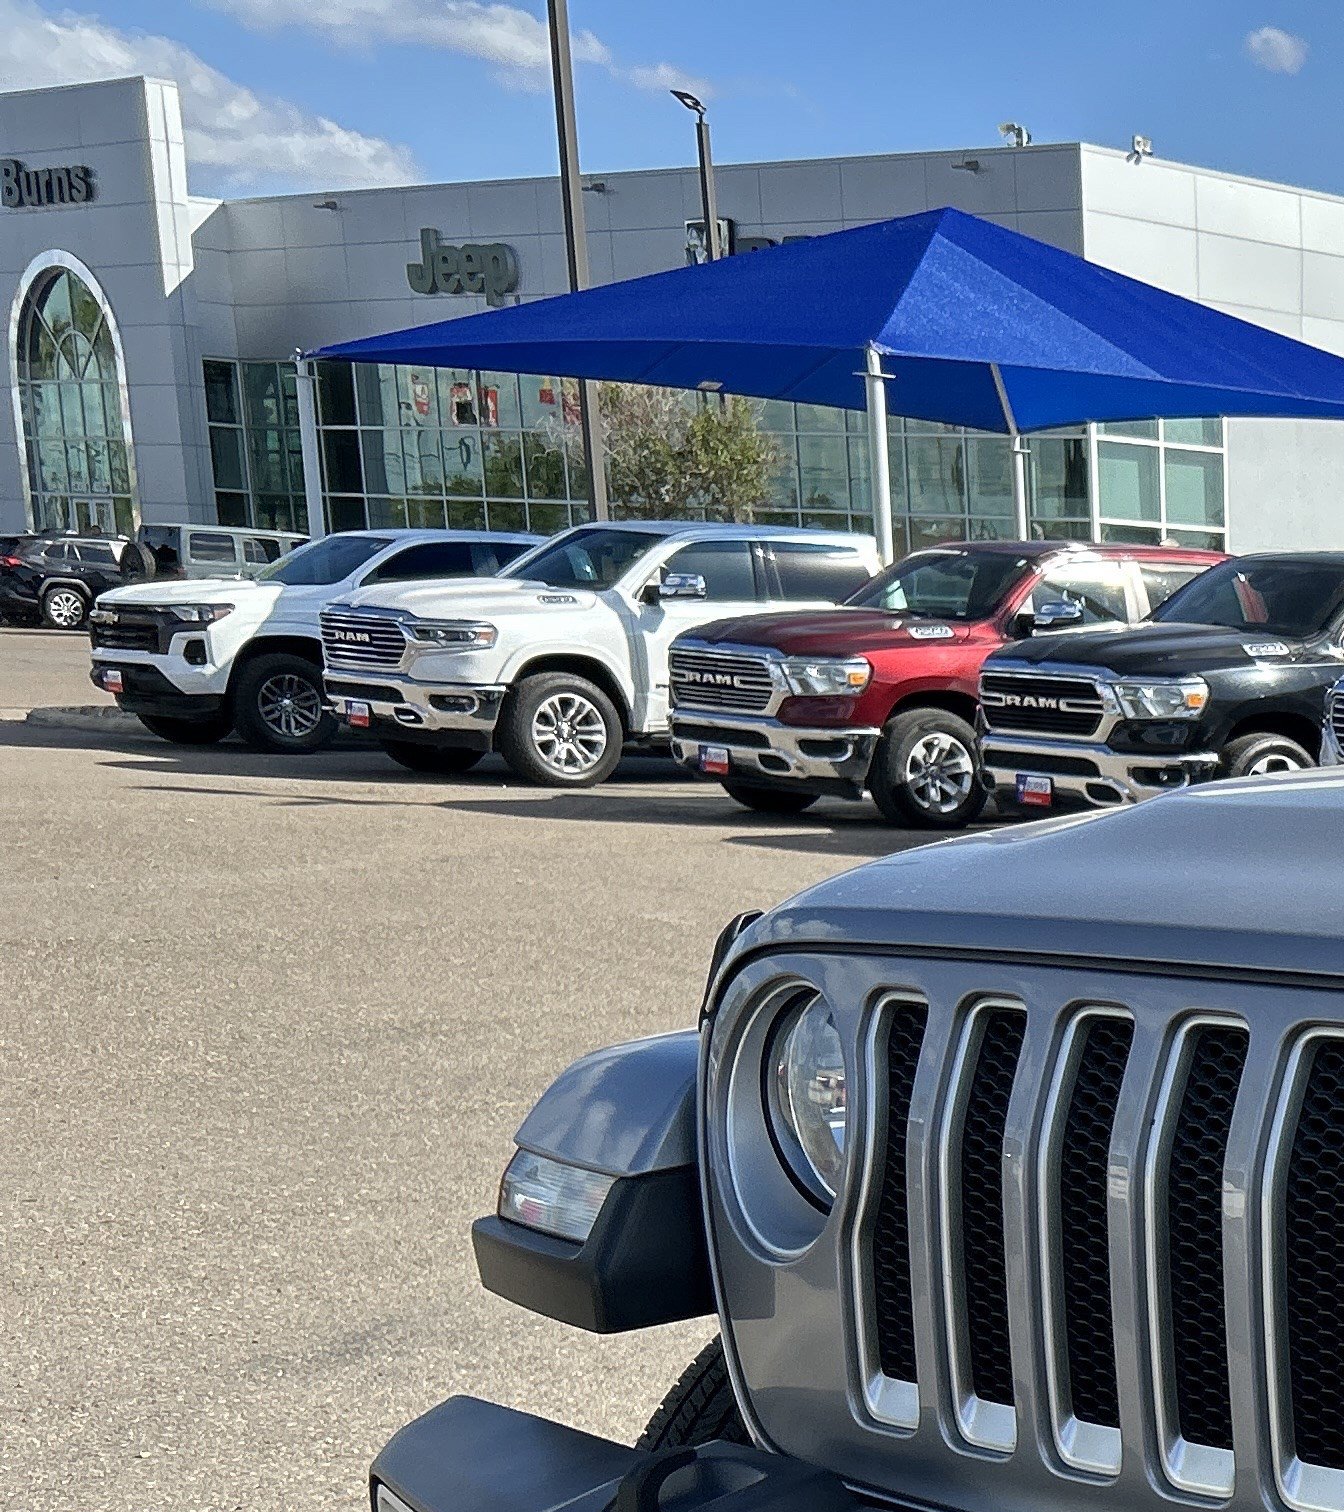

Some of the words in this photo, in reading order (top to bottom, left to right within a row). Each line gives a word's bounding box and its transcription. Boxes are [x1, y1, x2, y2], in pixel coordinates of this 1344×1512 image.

[0, 159, 92, 207] Burns
[407, 228, 519, 307] Jeep
[334, 630, 370, 643] RAM
[688, 672, 732, 686] RAM
[1004, 695, 1058, 709] RAM
